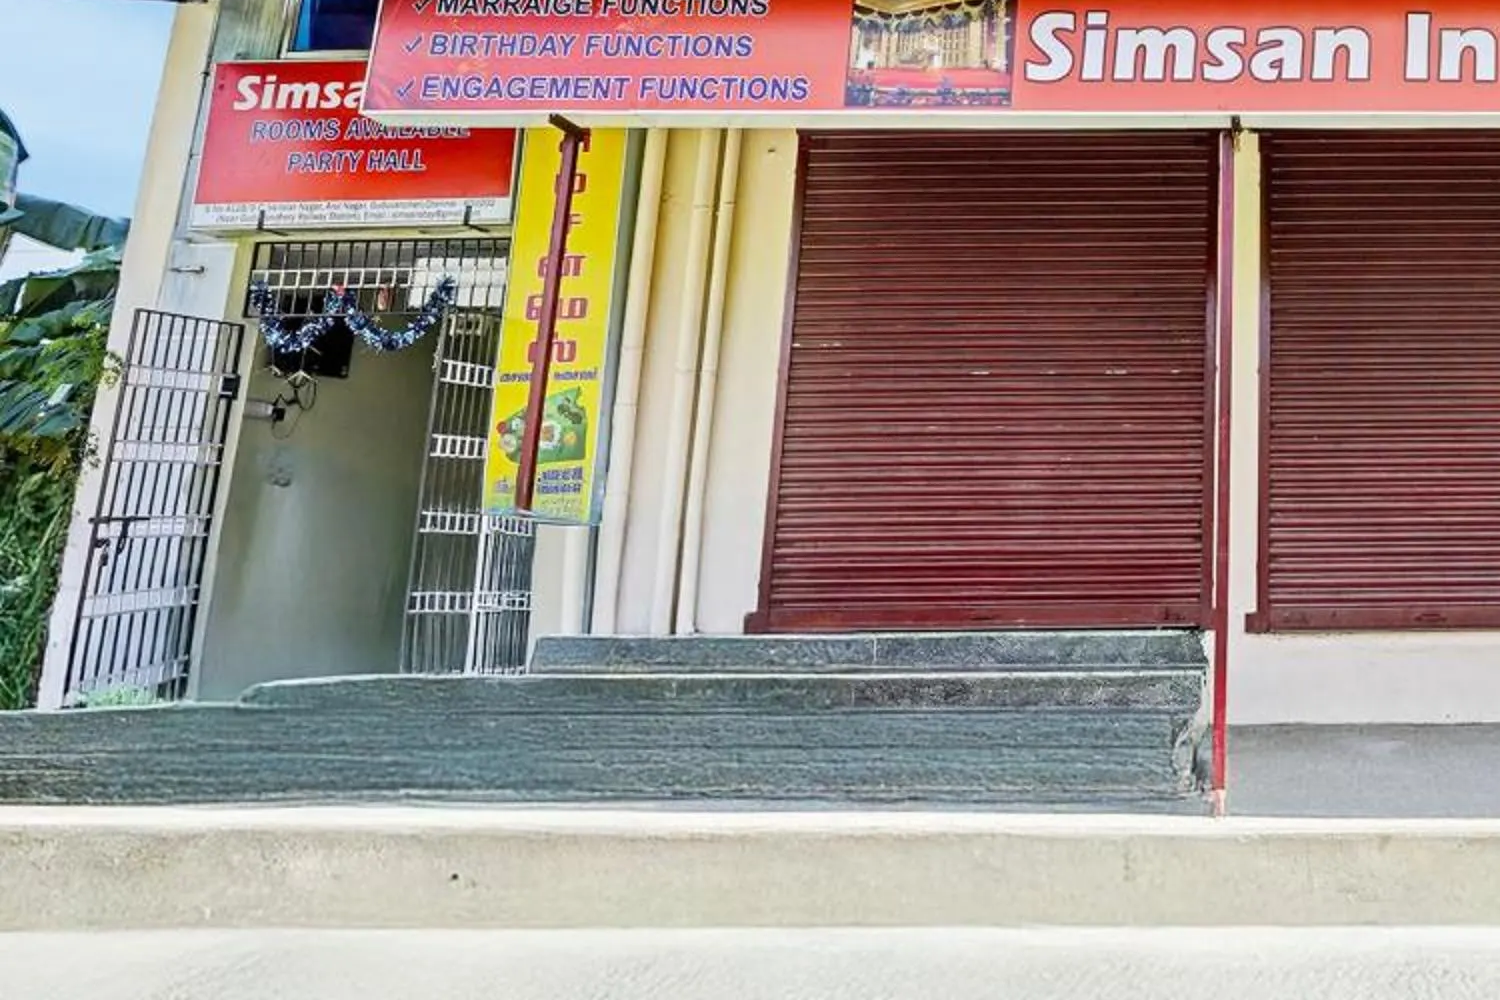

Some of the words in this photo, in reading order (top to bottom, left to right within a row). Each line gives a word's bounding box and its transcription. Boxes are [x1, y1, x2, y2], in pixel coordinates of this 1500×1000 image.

[429, 33, 575, 57] BIRTHDAY
[584, 34, 753, 58] FUNCTIONS
[1024, 10, 1371, 83] Simsan
[421, 75, 629, 100] ENGAGEMENT
[638, 76, 808, 100] FUNCTIONS
[251, 119, 340, 141] ROOMS
[287, 150, 364, 172] PARTY
[367, 149, 427, 171] HALL
